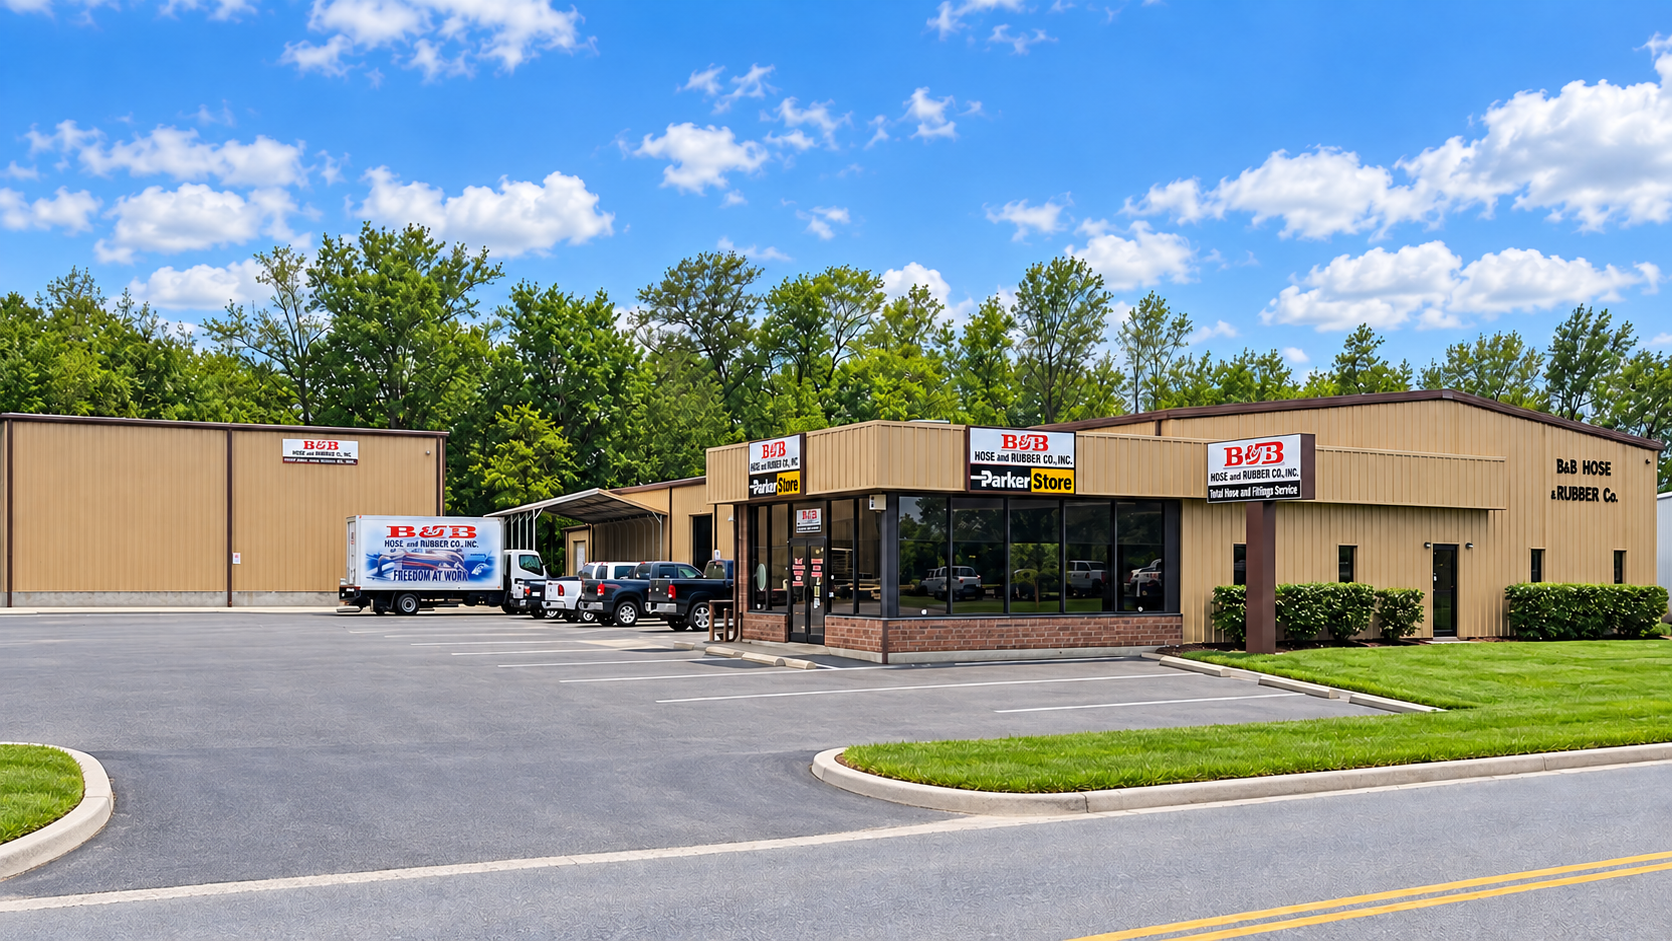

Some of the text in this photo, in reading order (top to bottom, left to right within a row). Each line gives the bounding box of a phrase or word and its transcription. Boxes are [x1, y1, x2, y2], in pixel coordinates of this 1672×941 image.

[303, 440, 339, 450] B&B
[761, 441, 786, 459] B&B
[1001, 434, 1049, 452] B&B
[974, 451, 995, 461] HOSE
[997, 453, 1009, 462] and
[1011, 453, 1041, 464] RUBBER
[1058, 455, 1073, 465] INC.
[1223, 441, 1284, 467] B&B
[1556, 458, 1611, 476] B&B HOSE
[1210, 471, 1228, 482] HOSE
[1229, 472, 1241, 481] and
[1243, 468, 1270, 480] RUBBER
[1285, 467, 1299, 477] INC.
[1240, 486, 1251, 497] and
[386, 525, 477, 539] B&B
[384, 540, 404, 548] HOSE
[420, 540, 449, 548] RUBBER
[393, 570, 469, 582] FREEDOM AT WORK
